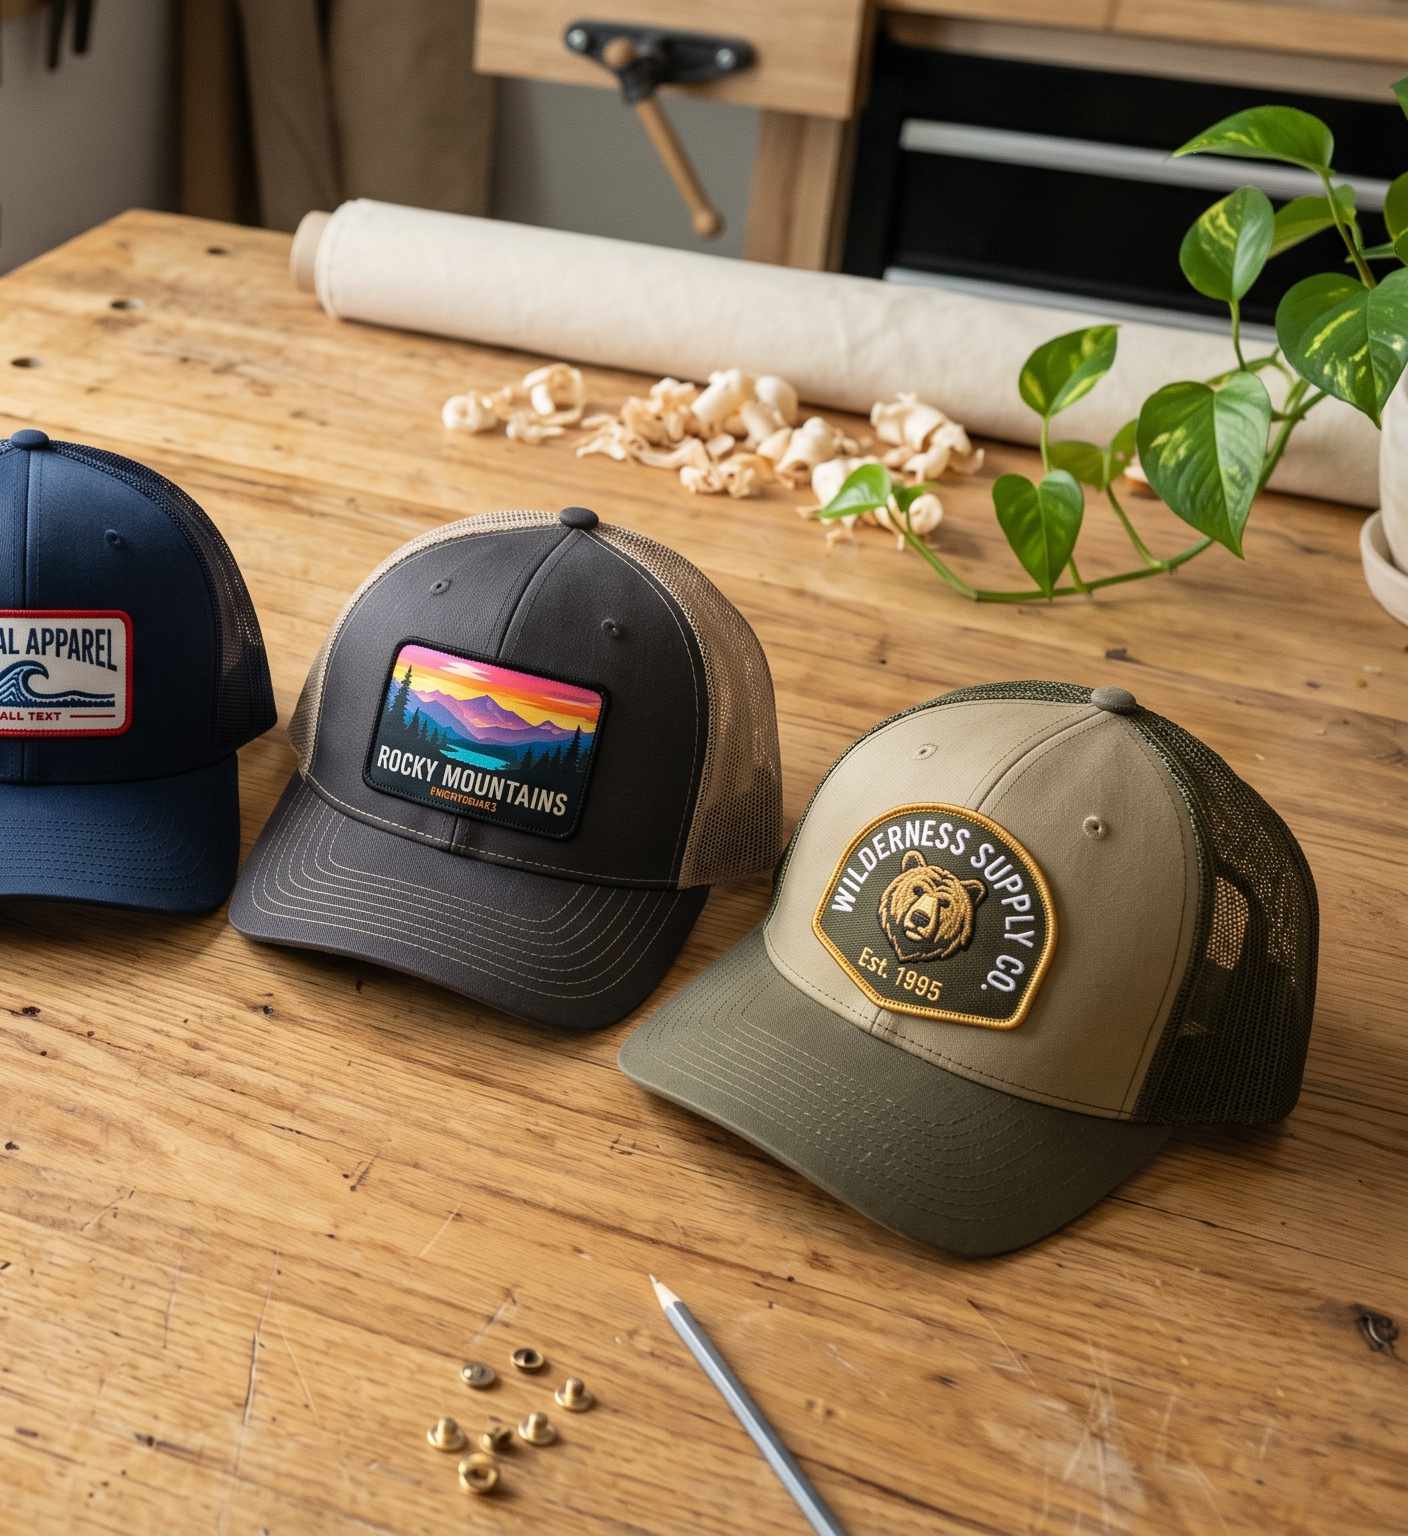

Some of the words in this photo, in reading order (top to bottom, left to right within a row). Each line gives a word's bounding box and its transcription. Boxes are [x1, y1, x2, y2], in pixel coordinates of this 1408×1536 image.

[25, 628, 117, 672] APPAREL
[28, 711, 62, 721] TEXT
[377, 745, 439, 783] ROCKY
[441, 764, 568, 816] MOUNTAINS
[831, 820, 971, 913] WILDERNESS
[970, 843, 1035, 948] SUPPLY
[858, 947, 888, 979] Est.
[895, 966, 942, 1001] 1995
[980, 954, 1025, 993] CO.
